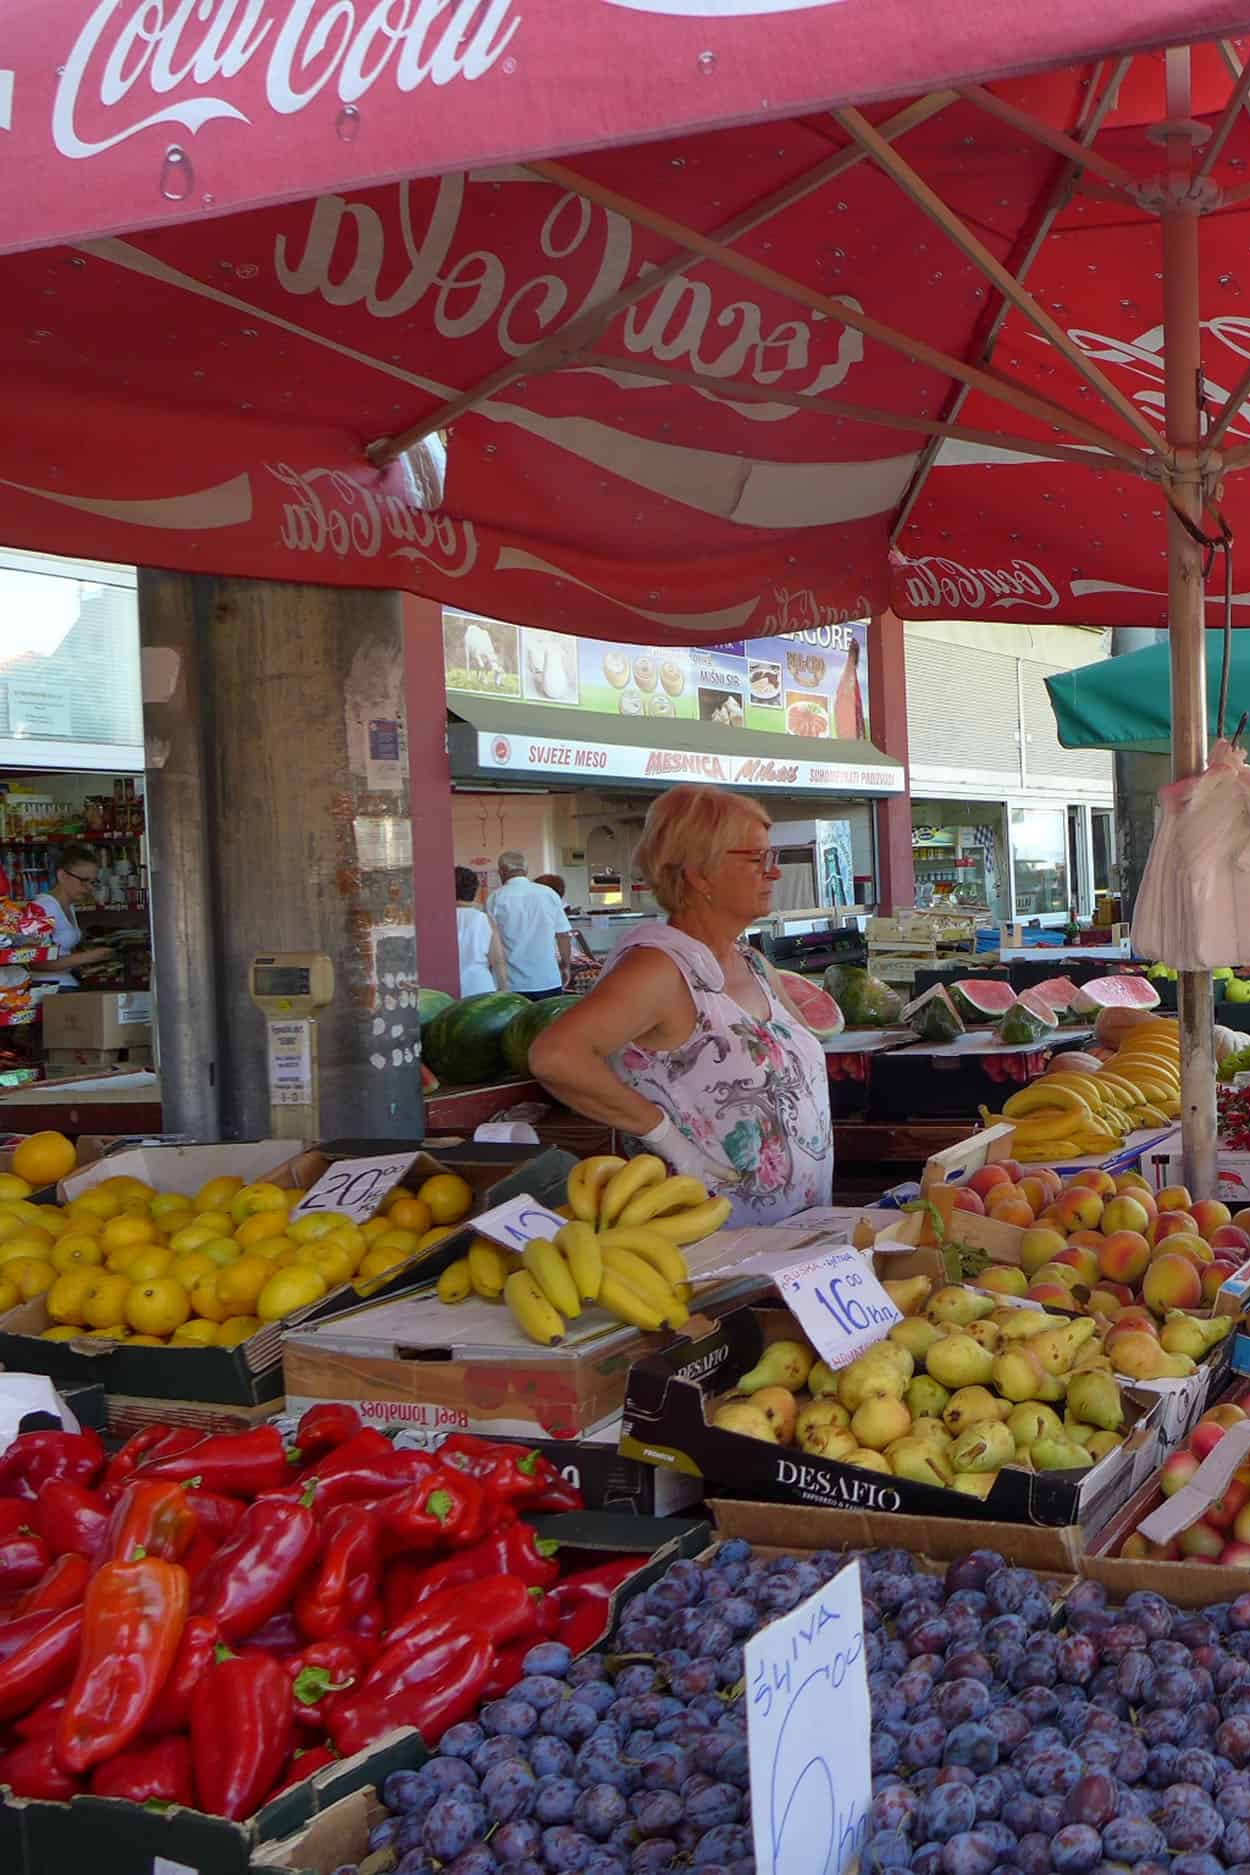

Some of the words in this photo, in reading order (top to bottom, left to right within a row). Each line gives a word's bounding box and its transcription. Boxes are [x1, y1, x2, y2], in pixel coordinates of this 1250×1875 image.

[528, 743, 572, 766] SVJEŽE
[574, 749, 608, 769] MESO
[644, 750, 727, 780] MESNICA
[299, 1168, 383, 1210] 20
[814, 1278, 870, 1335] 16
[845, 1273, 863, 1287] 00
[677, 1344, 729, 1380] DESAFIO
[360, 1400, 430, 1426] Tomatoes
[434, 1410, 469, 1428] Beef
[775, 1458, 901, 1512] DESAFIO
